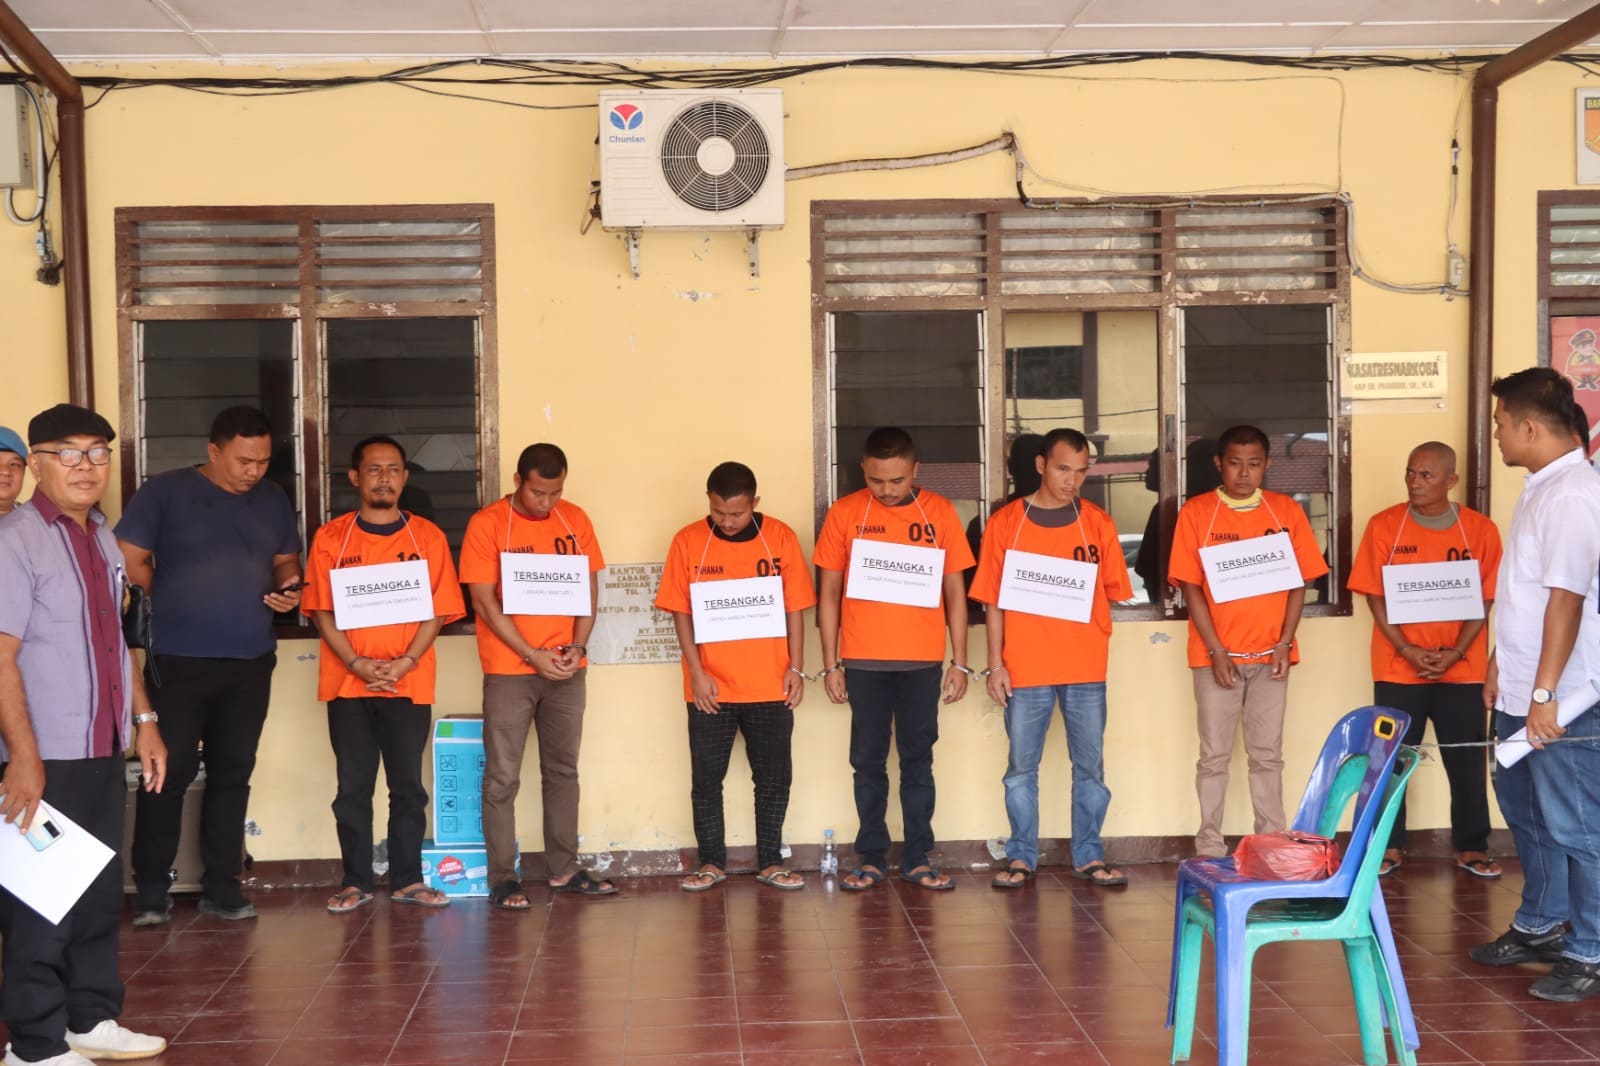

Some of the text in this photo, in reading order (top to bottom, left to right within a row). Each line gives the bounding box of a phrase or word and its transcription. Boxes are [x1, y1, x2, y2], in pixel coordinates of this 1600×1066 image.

[908, 522, 936, 543] 09
[554, 534, 576, 555] 07
[1073, 544, 1100, 564] 08
[1216, 550, 1286, 570] TERSANGKA 3
[609, 566, 646, 575] KANTOR
[756, 557, 782, 577] 05
[863, 557, 934, 573] TERSANGKA 1
[513, 571, 581, 581] TERSANGKA 7
[1015, 569, 1086, 588] TERSANGKA 2
[1397, 578, 1471, 591] TERSANGKA 6
[345, 578, 421, 595] TERSANGKA 4
[704, 594, 775, 609] TERSANGKA 5
